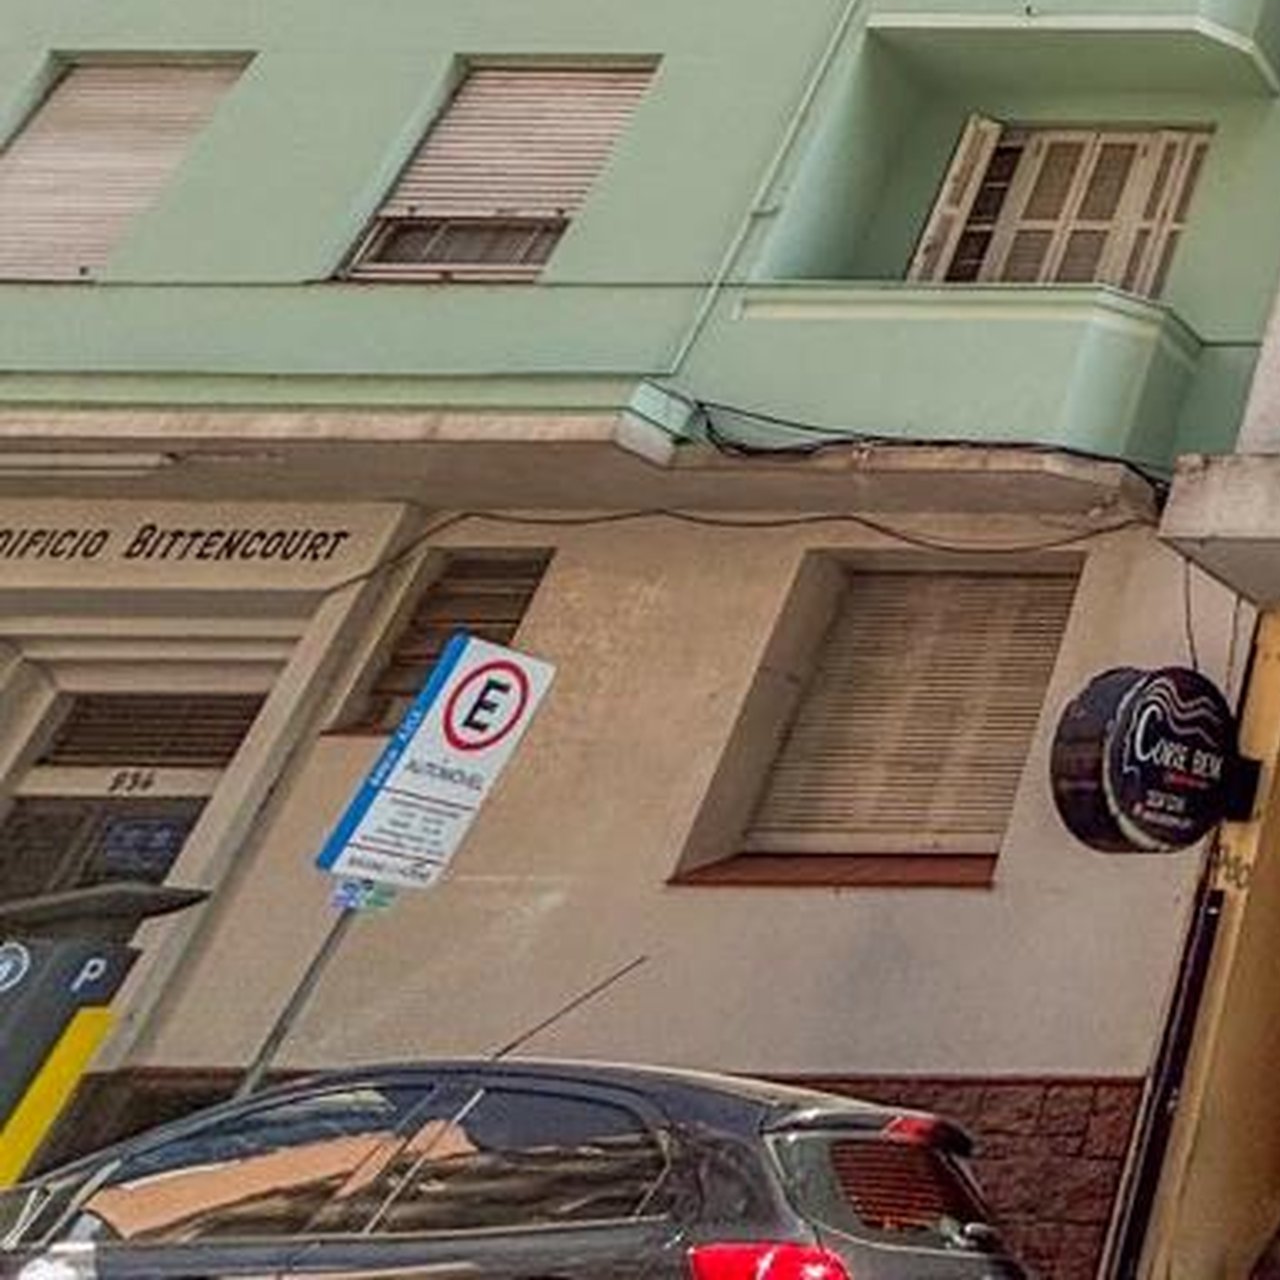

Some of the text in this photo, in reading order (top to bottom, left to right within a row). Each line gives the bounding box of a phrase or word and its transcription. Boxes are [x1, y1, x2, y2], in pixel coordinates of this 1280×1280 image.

[123, 523, 350, 561] BITTENCOURT
[462, 677, 511, 733] E
[70, 958, 107, 992] P
